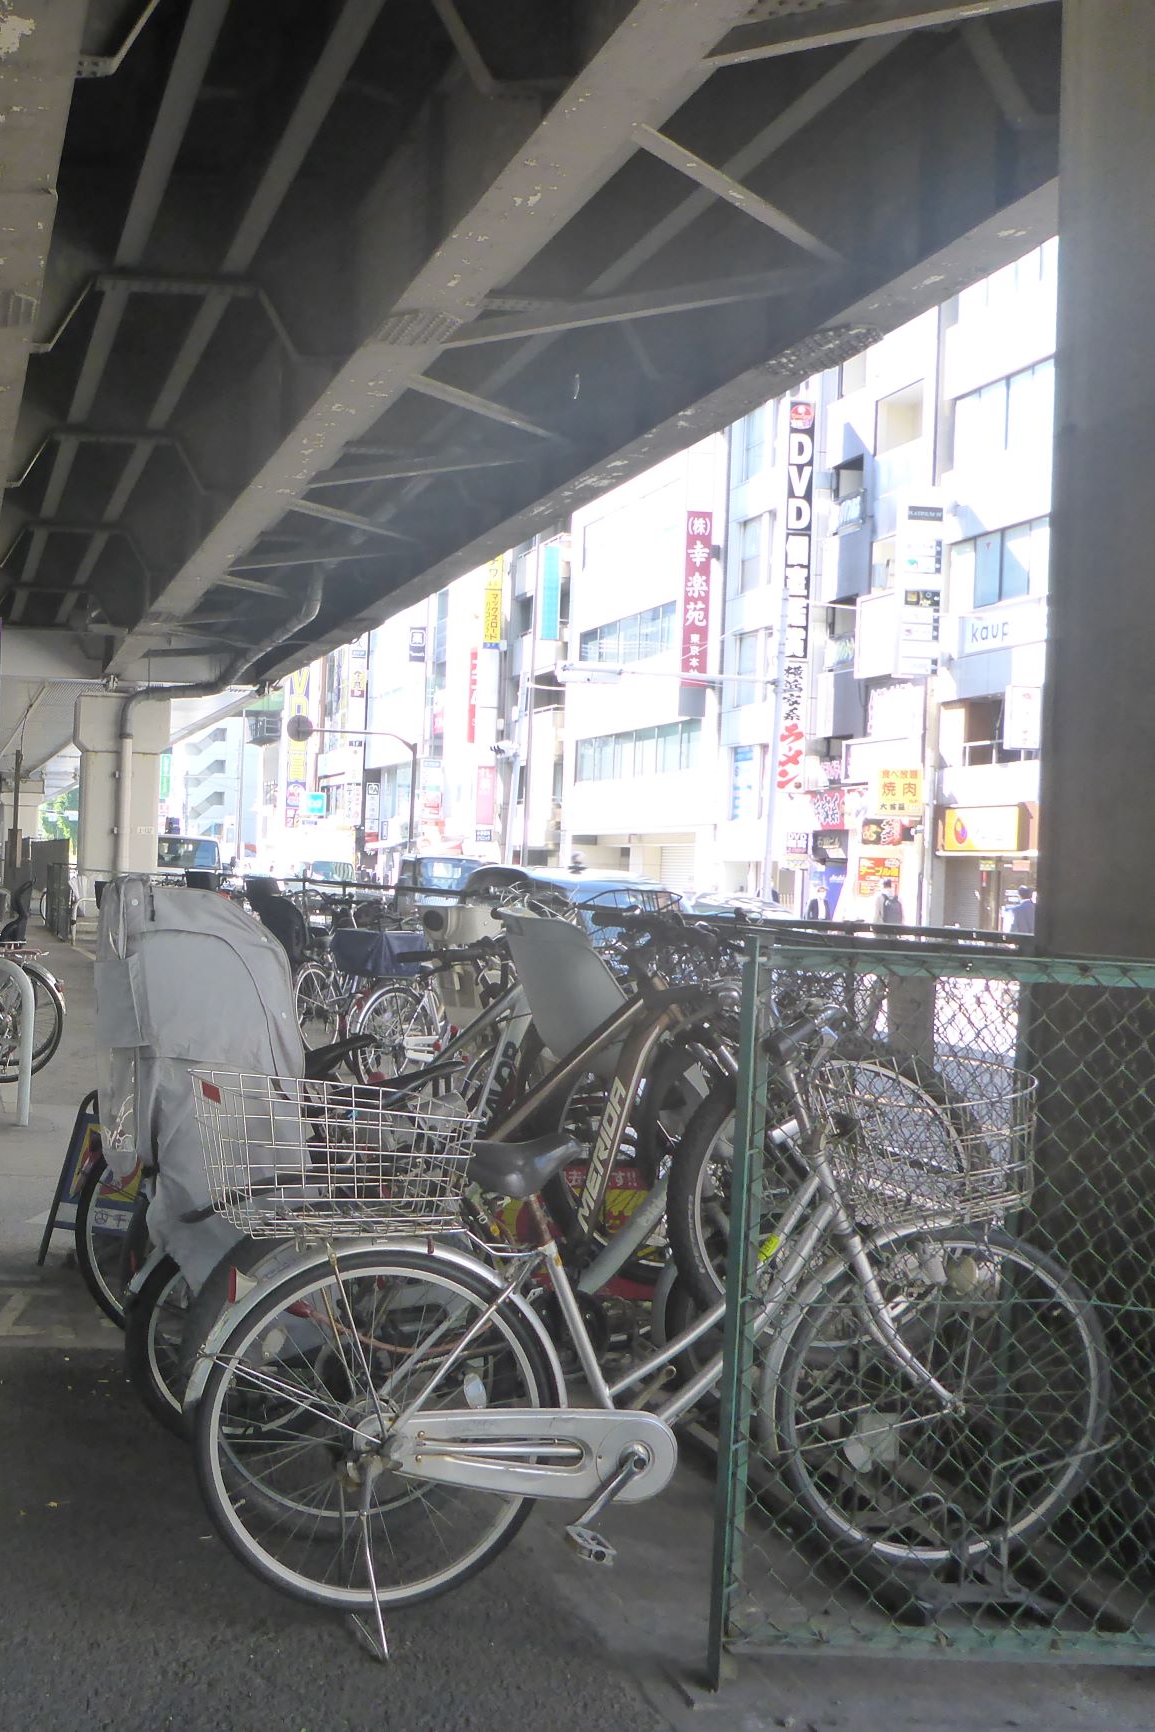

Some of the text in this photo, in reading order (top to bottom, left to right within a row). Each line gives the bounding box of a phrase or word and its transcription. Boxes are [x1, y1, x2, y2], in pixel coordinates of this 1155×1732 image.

[788, 433, 813, 530] DVD
[881, 782, 917, 798] 焼肉
[578, 1077, 627, 1234] MERIDA
